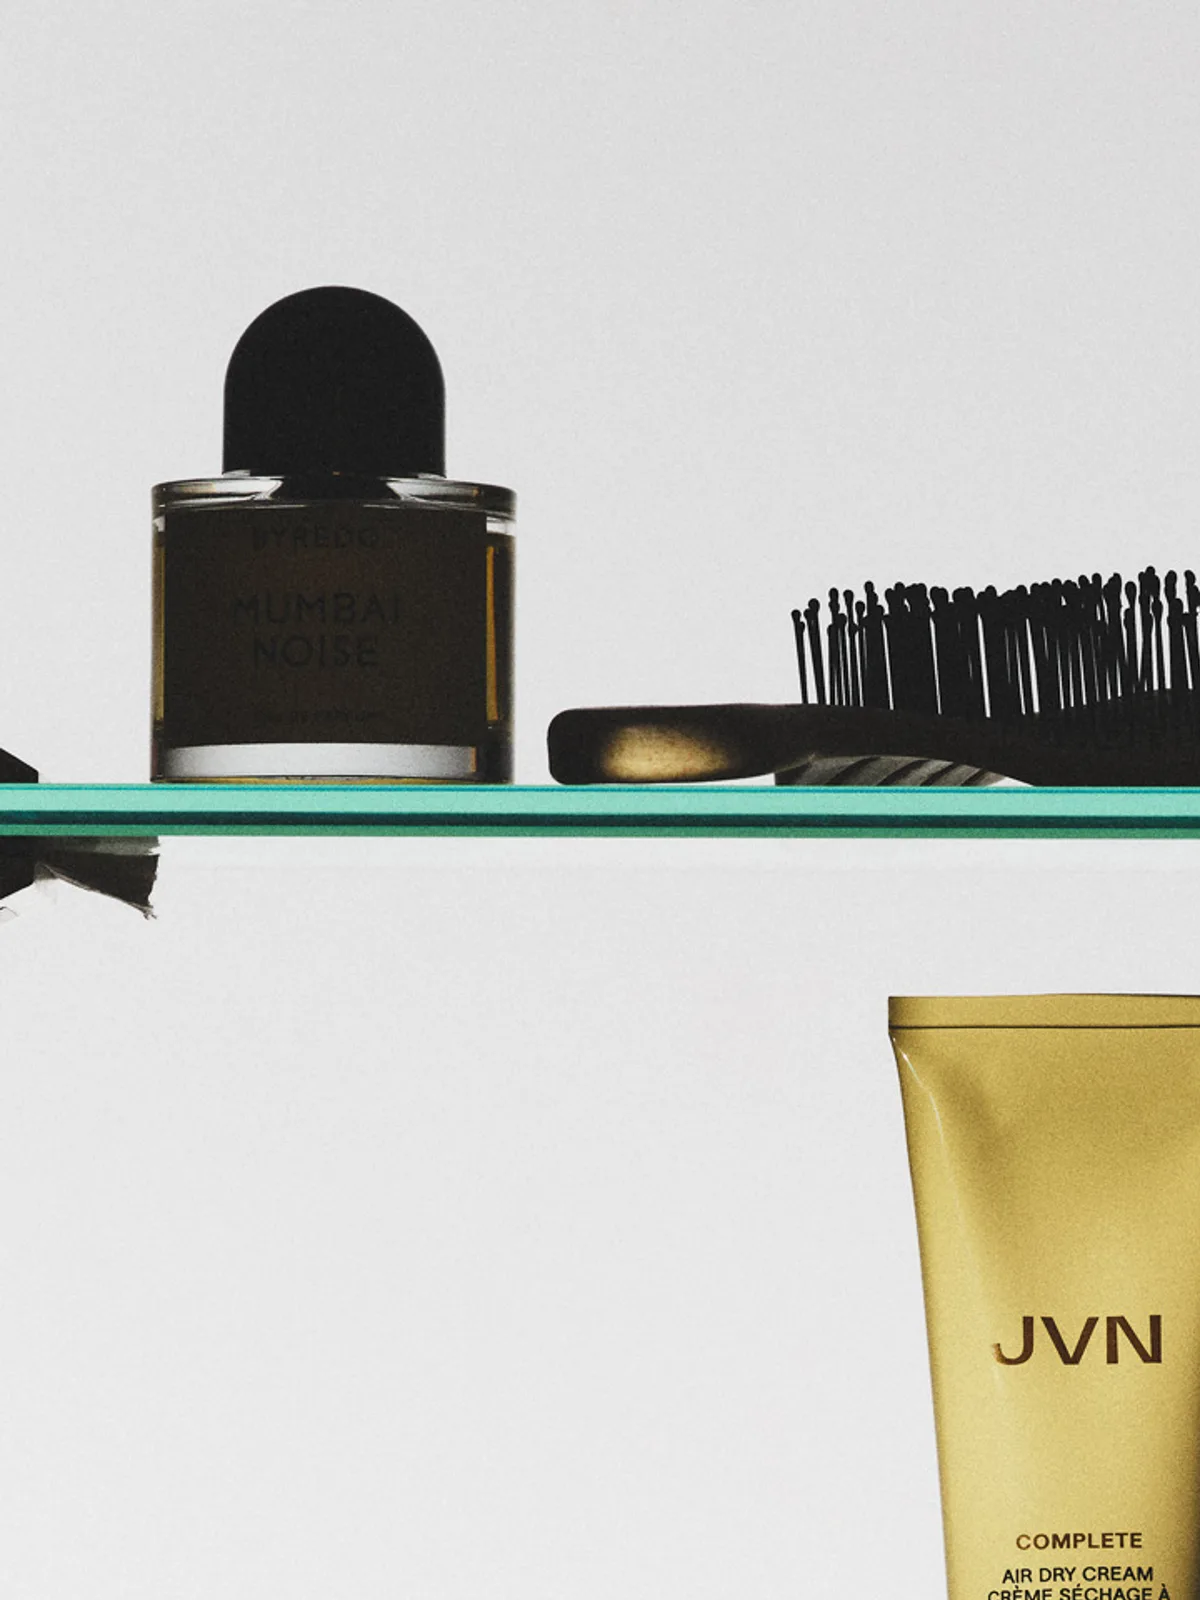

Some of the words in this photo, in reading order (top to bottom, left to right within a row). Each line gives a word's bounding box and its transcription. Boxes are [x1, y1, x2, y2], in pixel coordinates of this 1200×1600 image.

[231, 592, 402, 625] MUMBAI
[253, 634, 379, 670] NOISE
[991, 1315, 1162, 1365] JVN
[1016, 1532, 1143, 1550] COMPLETE
[1002, 1568, 1032, 1584] AIR
[1039, 1567, 1076, 1583] DRY
[1082, 1566, 1154, 1582] CREAM
